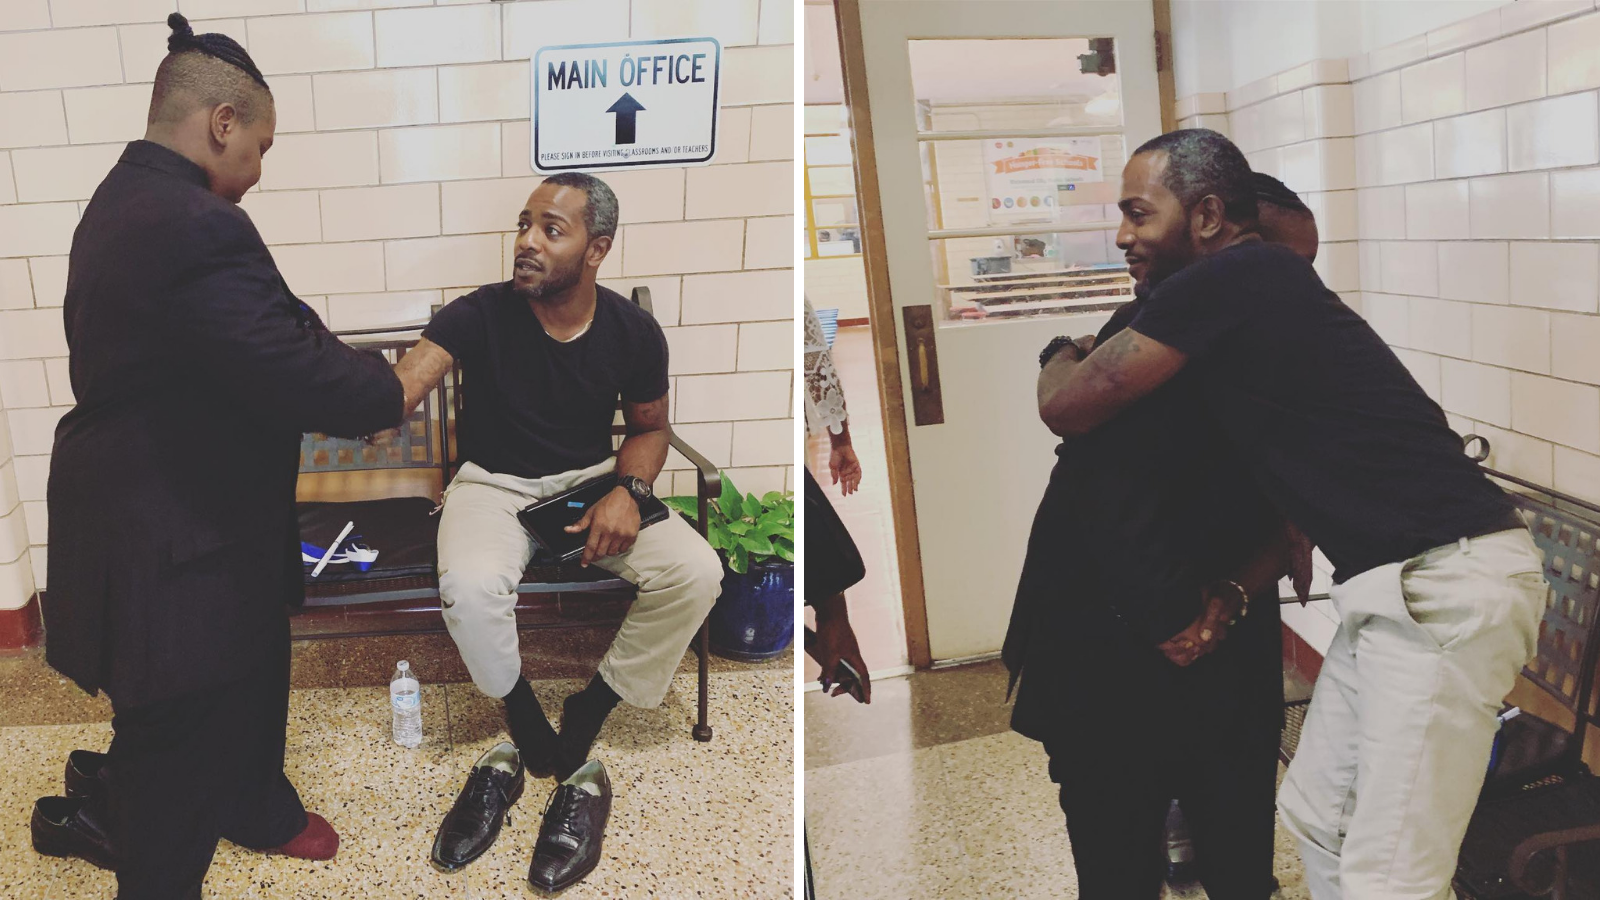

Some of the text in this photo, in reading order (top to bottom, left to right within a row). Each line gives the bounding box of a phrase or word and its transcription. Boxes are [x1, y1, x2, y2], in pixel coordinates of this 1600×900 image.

[548, 54, 707, 91] MAIN OFFICE
[541, 152, 560, 161] PLEASE
[561, 151, 574, 160] SIGN
[575, 151, 581, 159] IN
[582, 150, 601, 159] BEFORE
[602, 149, 623, 158] VISITING
[682, 144, 709, 153] TEACHERS
